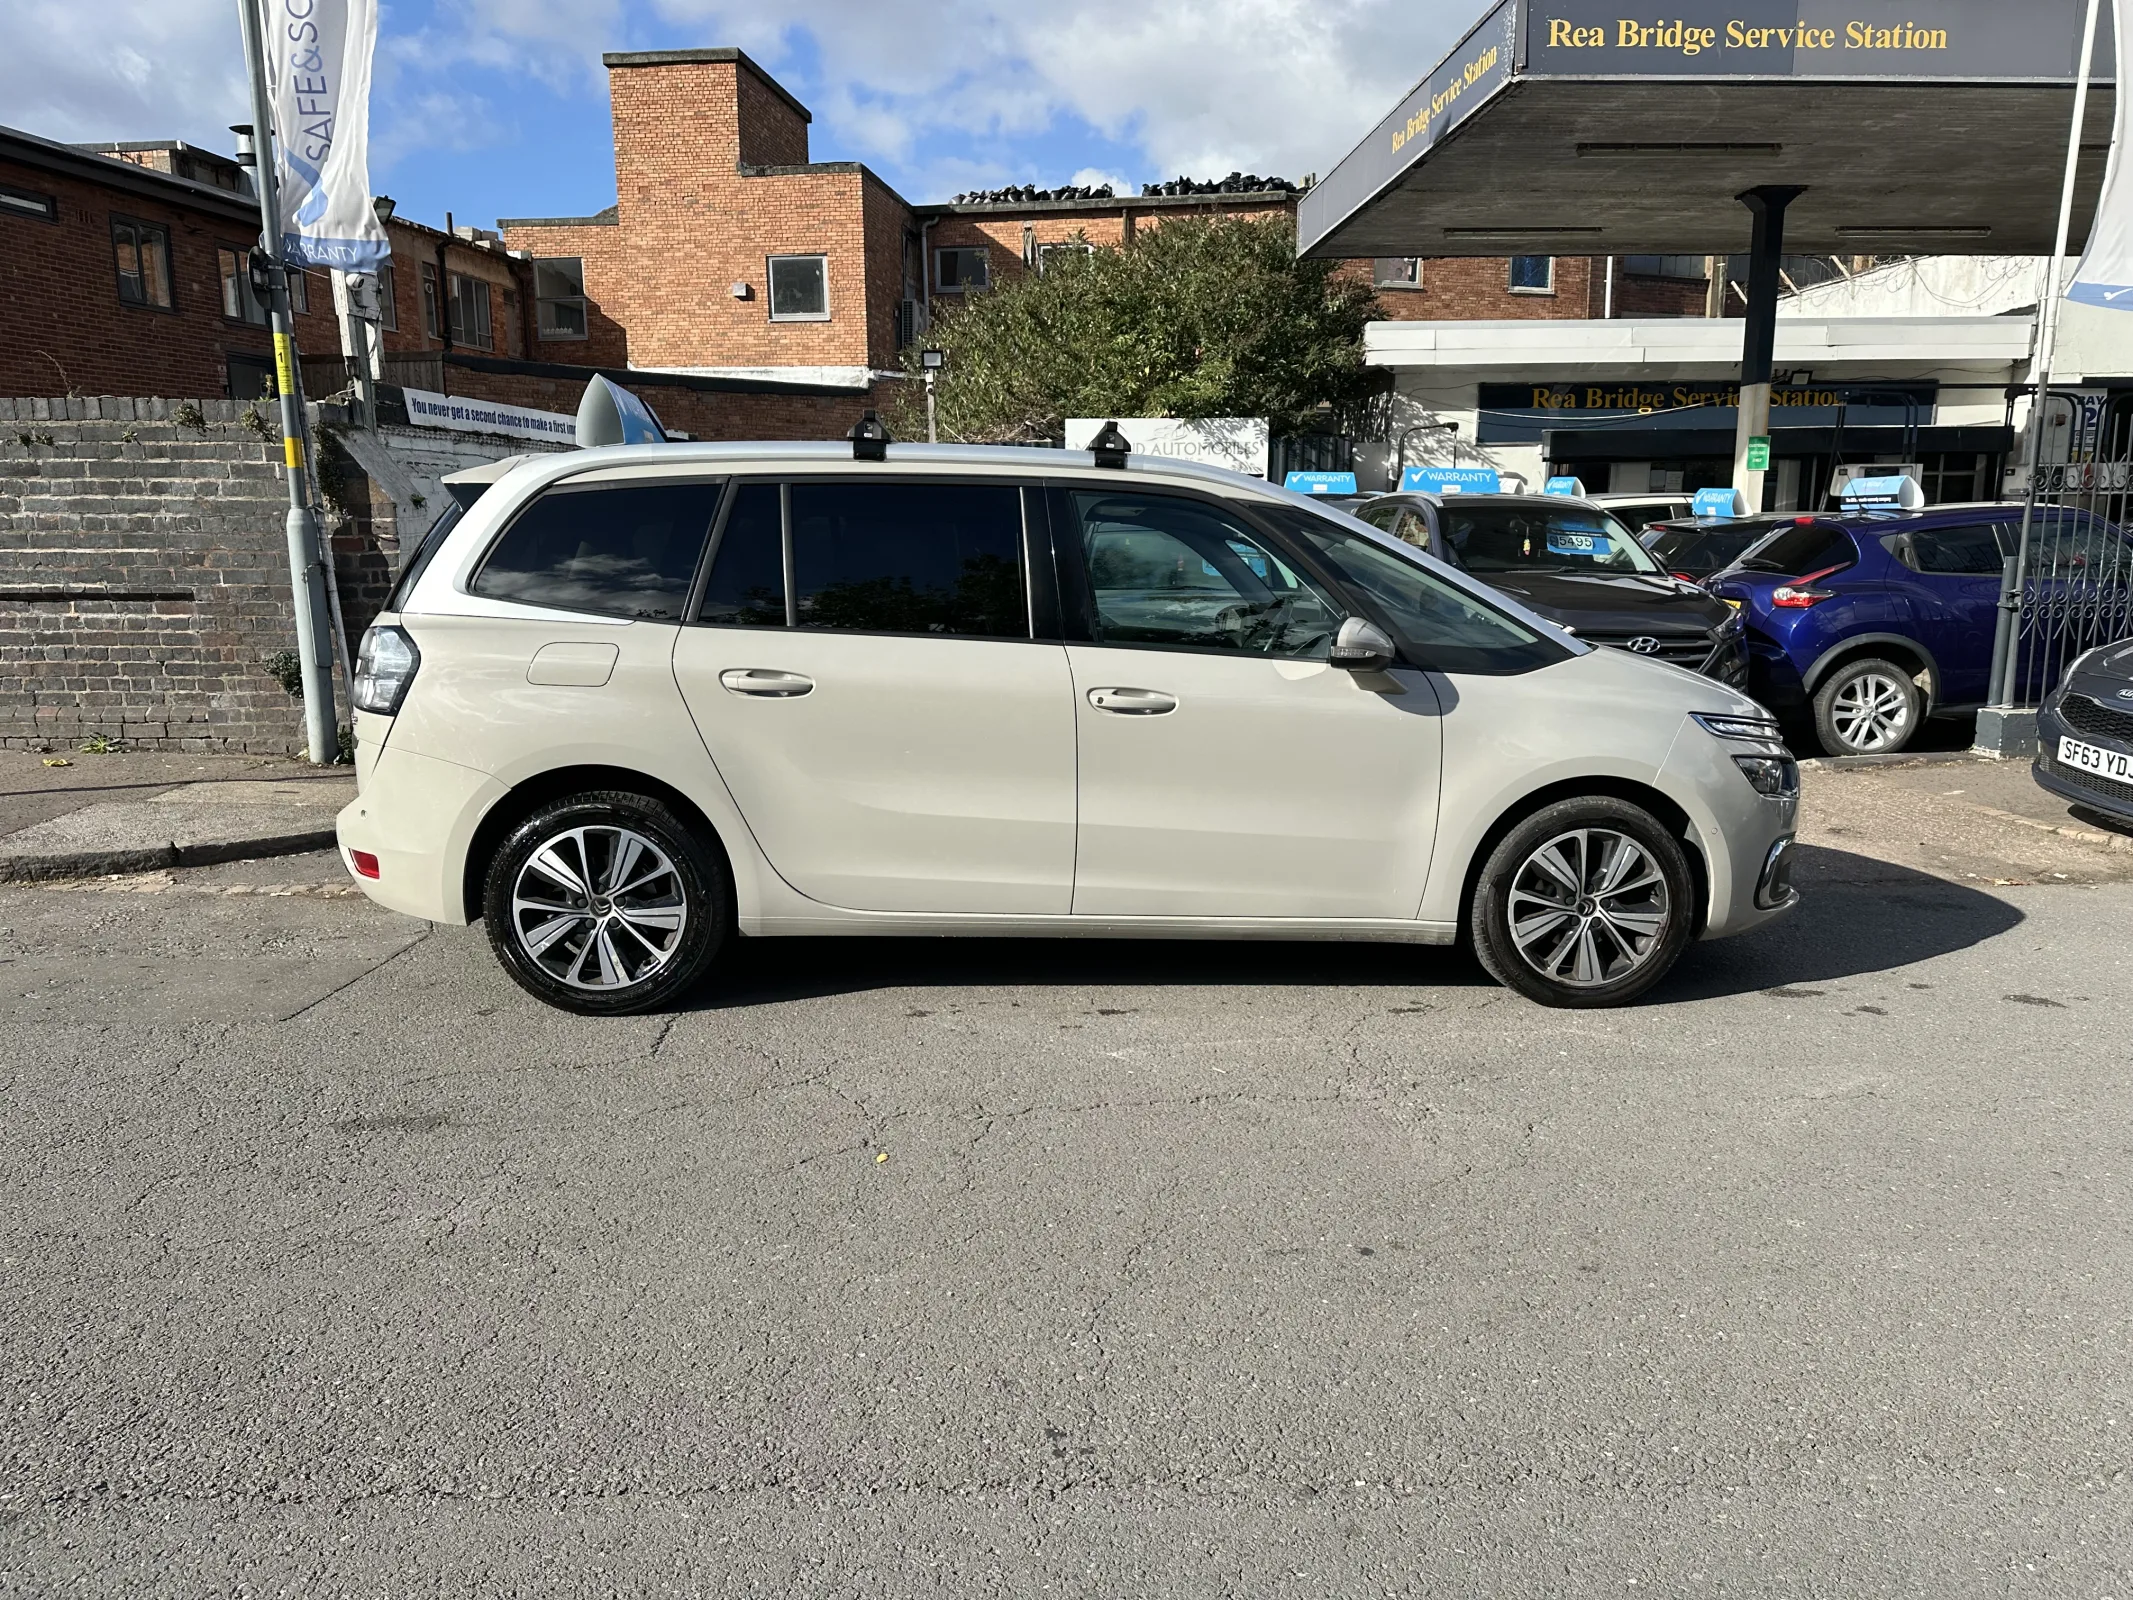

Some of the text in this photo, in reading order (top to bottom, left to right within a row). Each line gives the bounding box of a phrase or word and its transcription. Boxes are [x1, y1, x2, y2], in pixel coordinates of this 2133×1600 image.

[1547, 19, 1948, 56] Rea Bridge Service Station
[1391, 45, 1498, 155] Rea Bridge Service Station
[277, 352, 284, 363] 1
[1532, 388, 1576, 409] Rea
[1585, 387, 1665, 414] Bridge
[1673, 386, 1740, 408] Servic
[411, 397, 428, 415] You
[428, 402, 450, 418] never
[451, 405, 465, 420] get
[465, 408, 471, 420] a
[471, 409, 497, 425] second
[497, 411, 522, 429] chance
[522, 415, 530, 429] to
[530, 417, 548, 432] make
[548, 420, 553, 432] a
[553, 419, 567, 434] first
[1151, 441, 1260, 456] AUTOMOBILES
[1303, 474, 1352, 483] WARRANTY
[1426, 471, 1492, 483] WARRANTY
[1703, 493, 1733, 504] WARRANTY
[2064, 740, 2133, 780] SF63 YD
